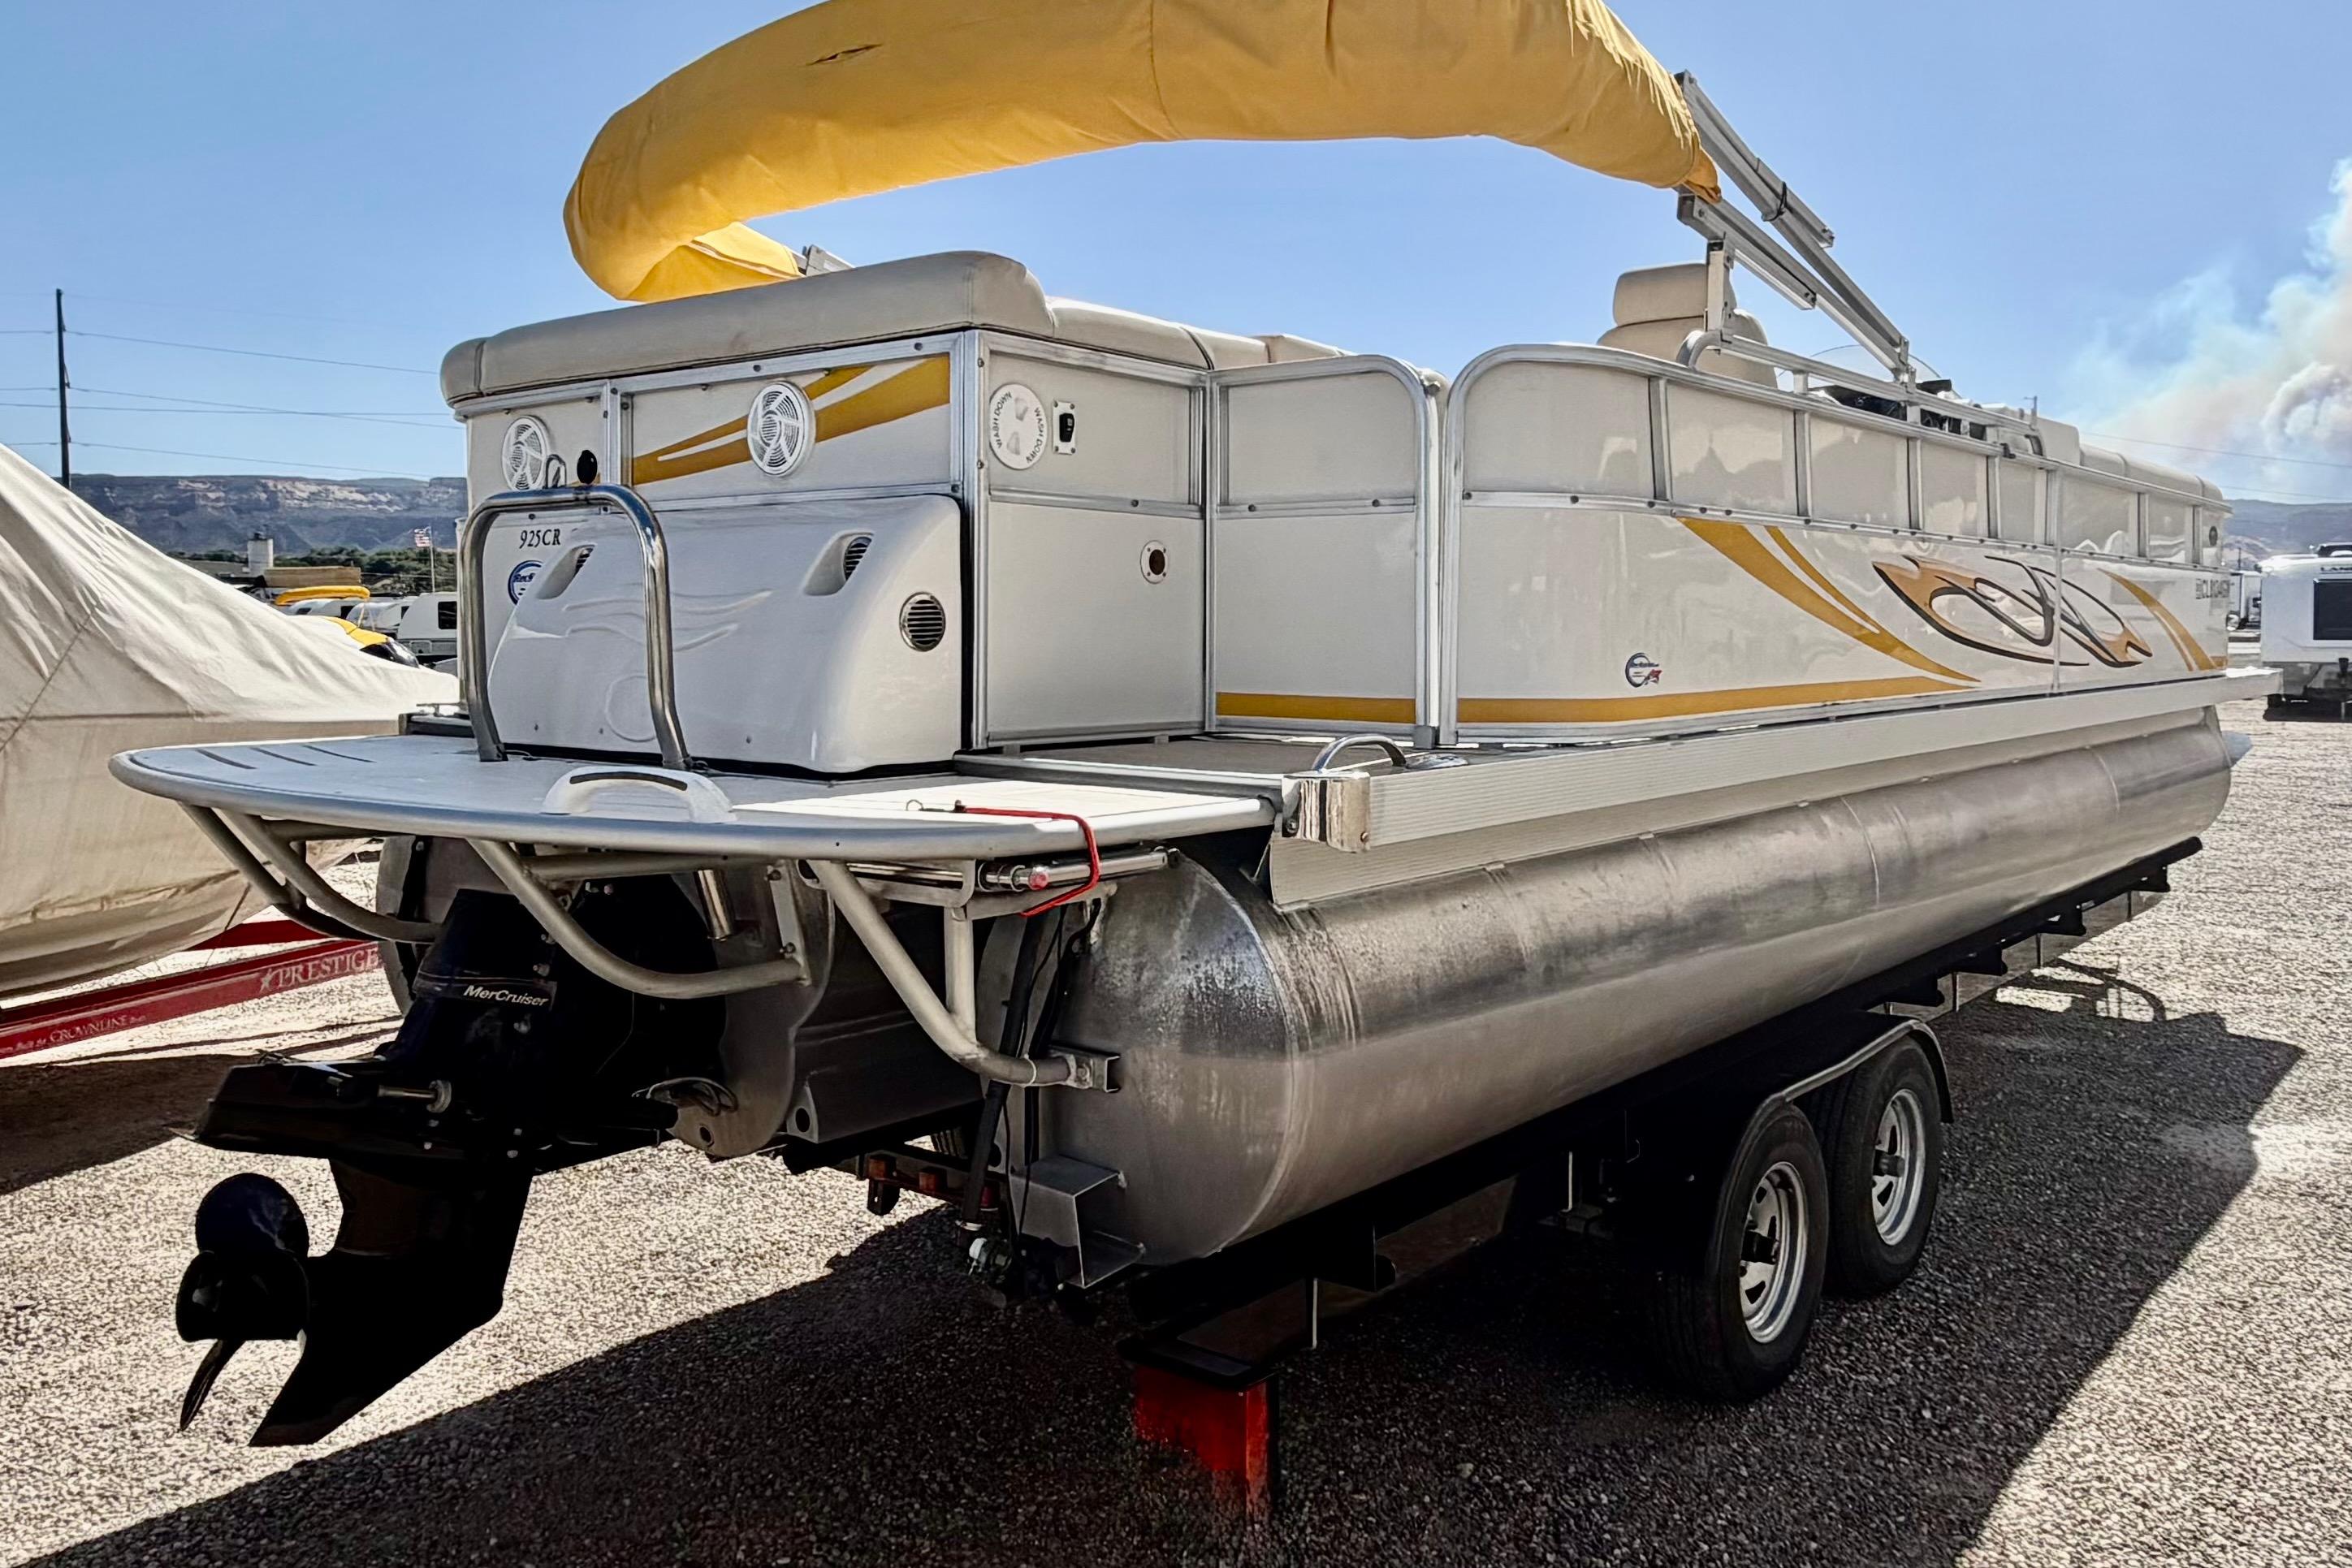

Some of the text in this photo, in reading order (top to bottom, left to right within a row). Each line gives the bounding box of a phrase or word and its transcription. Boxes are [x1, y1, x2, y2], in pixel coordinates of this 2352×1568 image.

[994, 391, 1013, 417] DOWN
[1026, 438, 1044, 464] DOWN
[519, 529, 561, 549] 925CR
[278, 947, 379, 988] PRESTIGE
[463, 985, 548, 1006] MerCruiser
[50, 1015, 128, 1043] CROWNLINE
